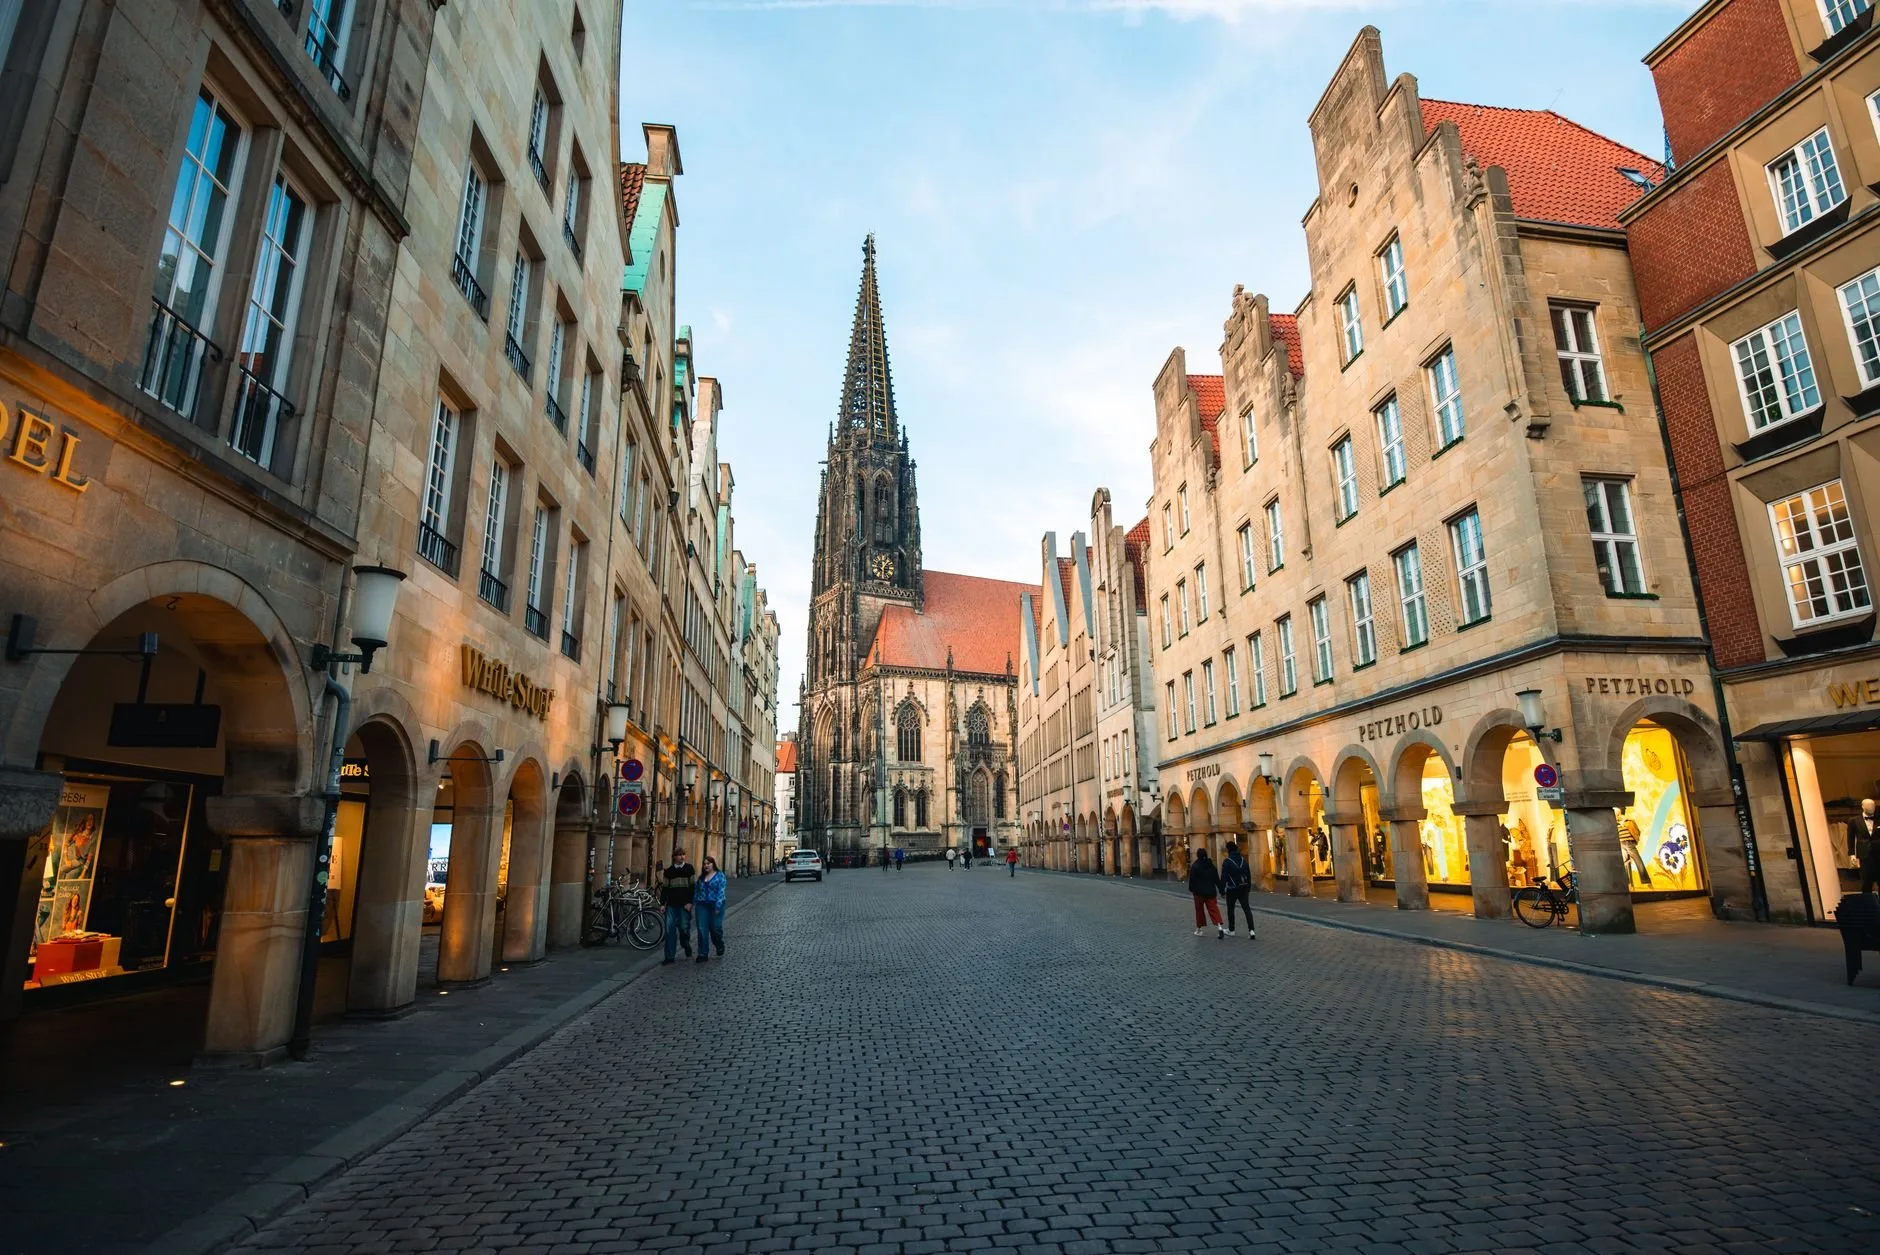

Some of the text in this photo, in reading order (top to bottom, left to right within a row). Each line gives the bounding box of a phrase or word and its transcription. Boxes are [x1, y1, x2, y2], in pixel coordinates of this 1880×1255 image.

[0, 401, 90, 493] EL
[1584, 677, 1695, 696] PETZHOLD
[1358, 705, 1443, 743] PETZHOLD
[1186, 763, 1221, 782] PETZHOLD
[60, 791, 86, 804] RESH
